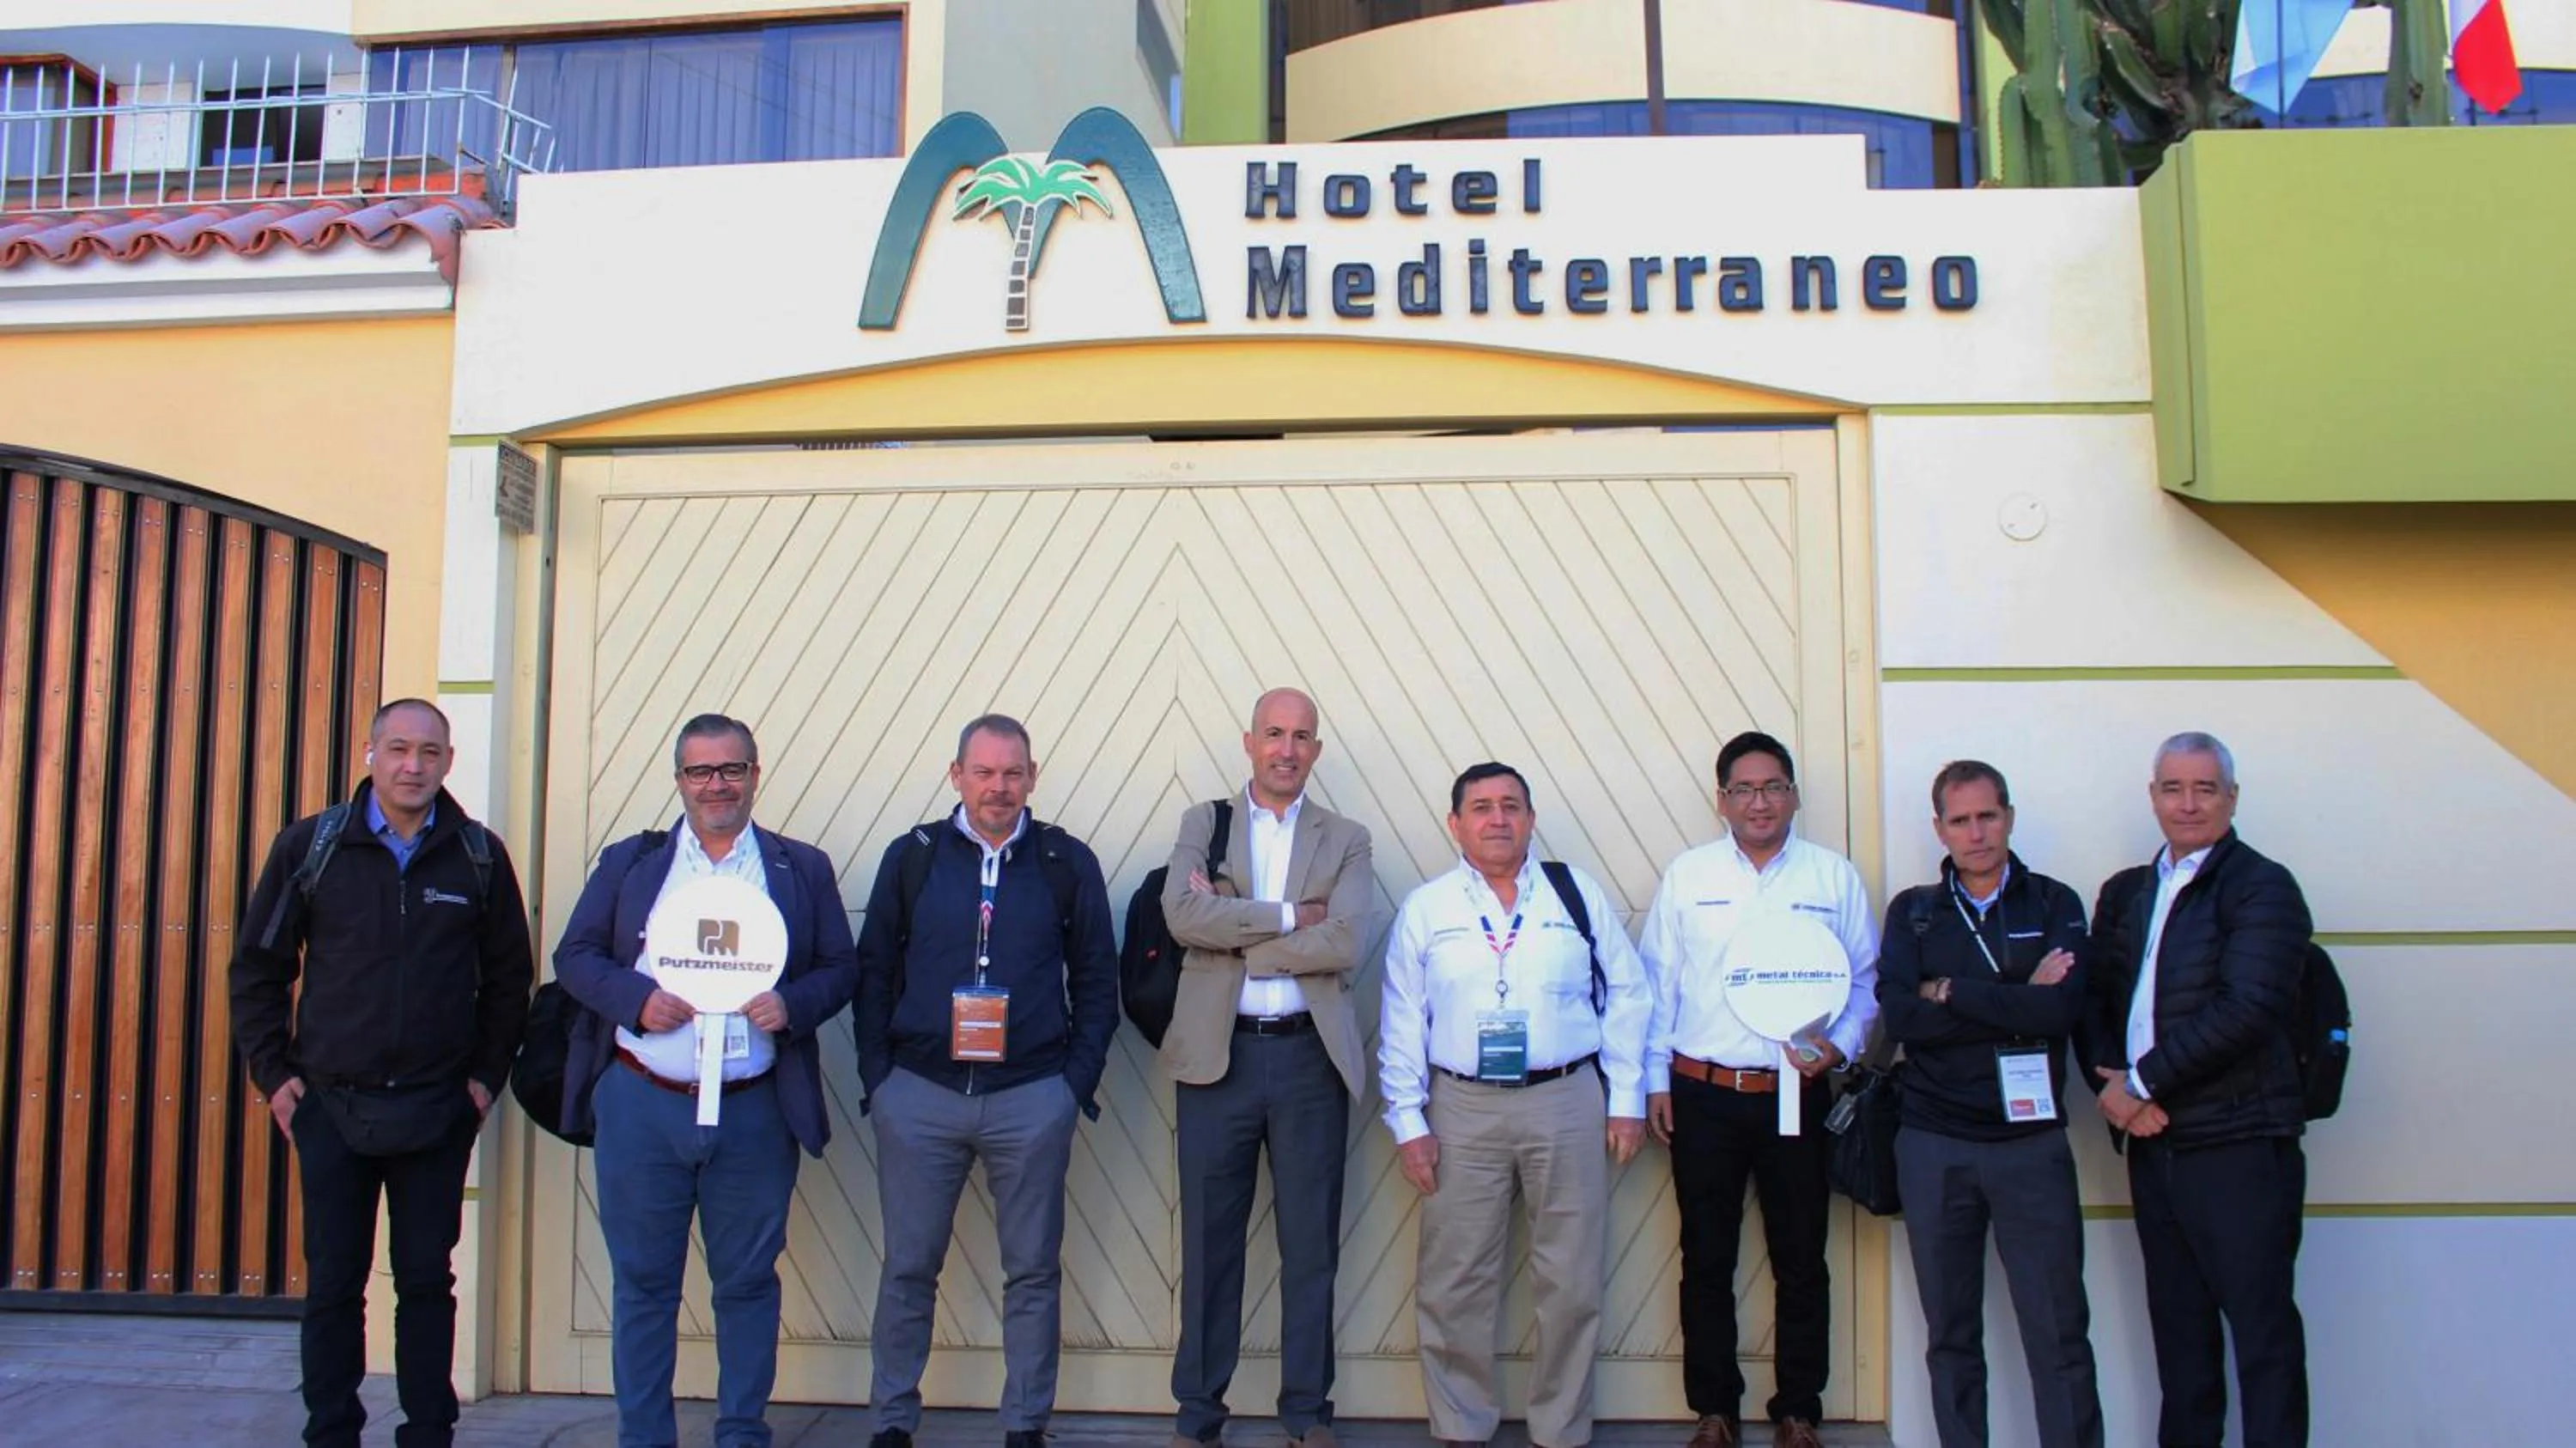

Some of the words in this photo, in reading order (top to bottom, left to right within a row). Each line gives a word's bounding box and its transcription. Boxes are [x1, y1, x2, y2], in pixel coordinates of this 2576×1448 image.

[1245, 158, 1542, 219] Hotel
[1246, 238, 1978, 319] Mediterraneo
[658, 956, 775, 973] Putzmeister
